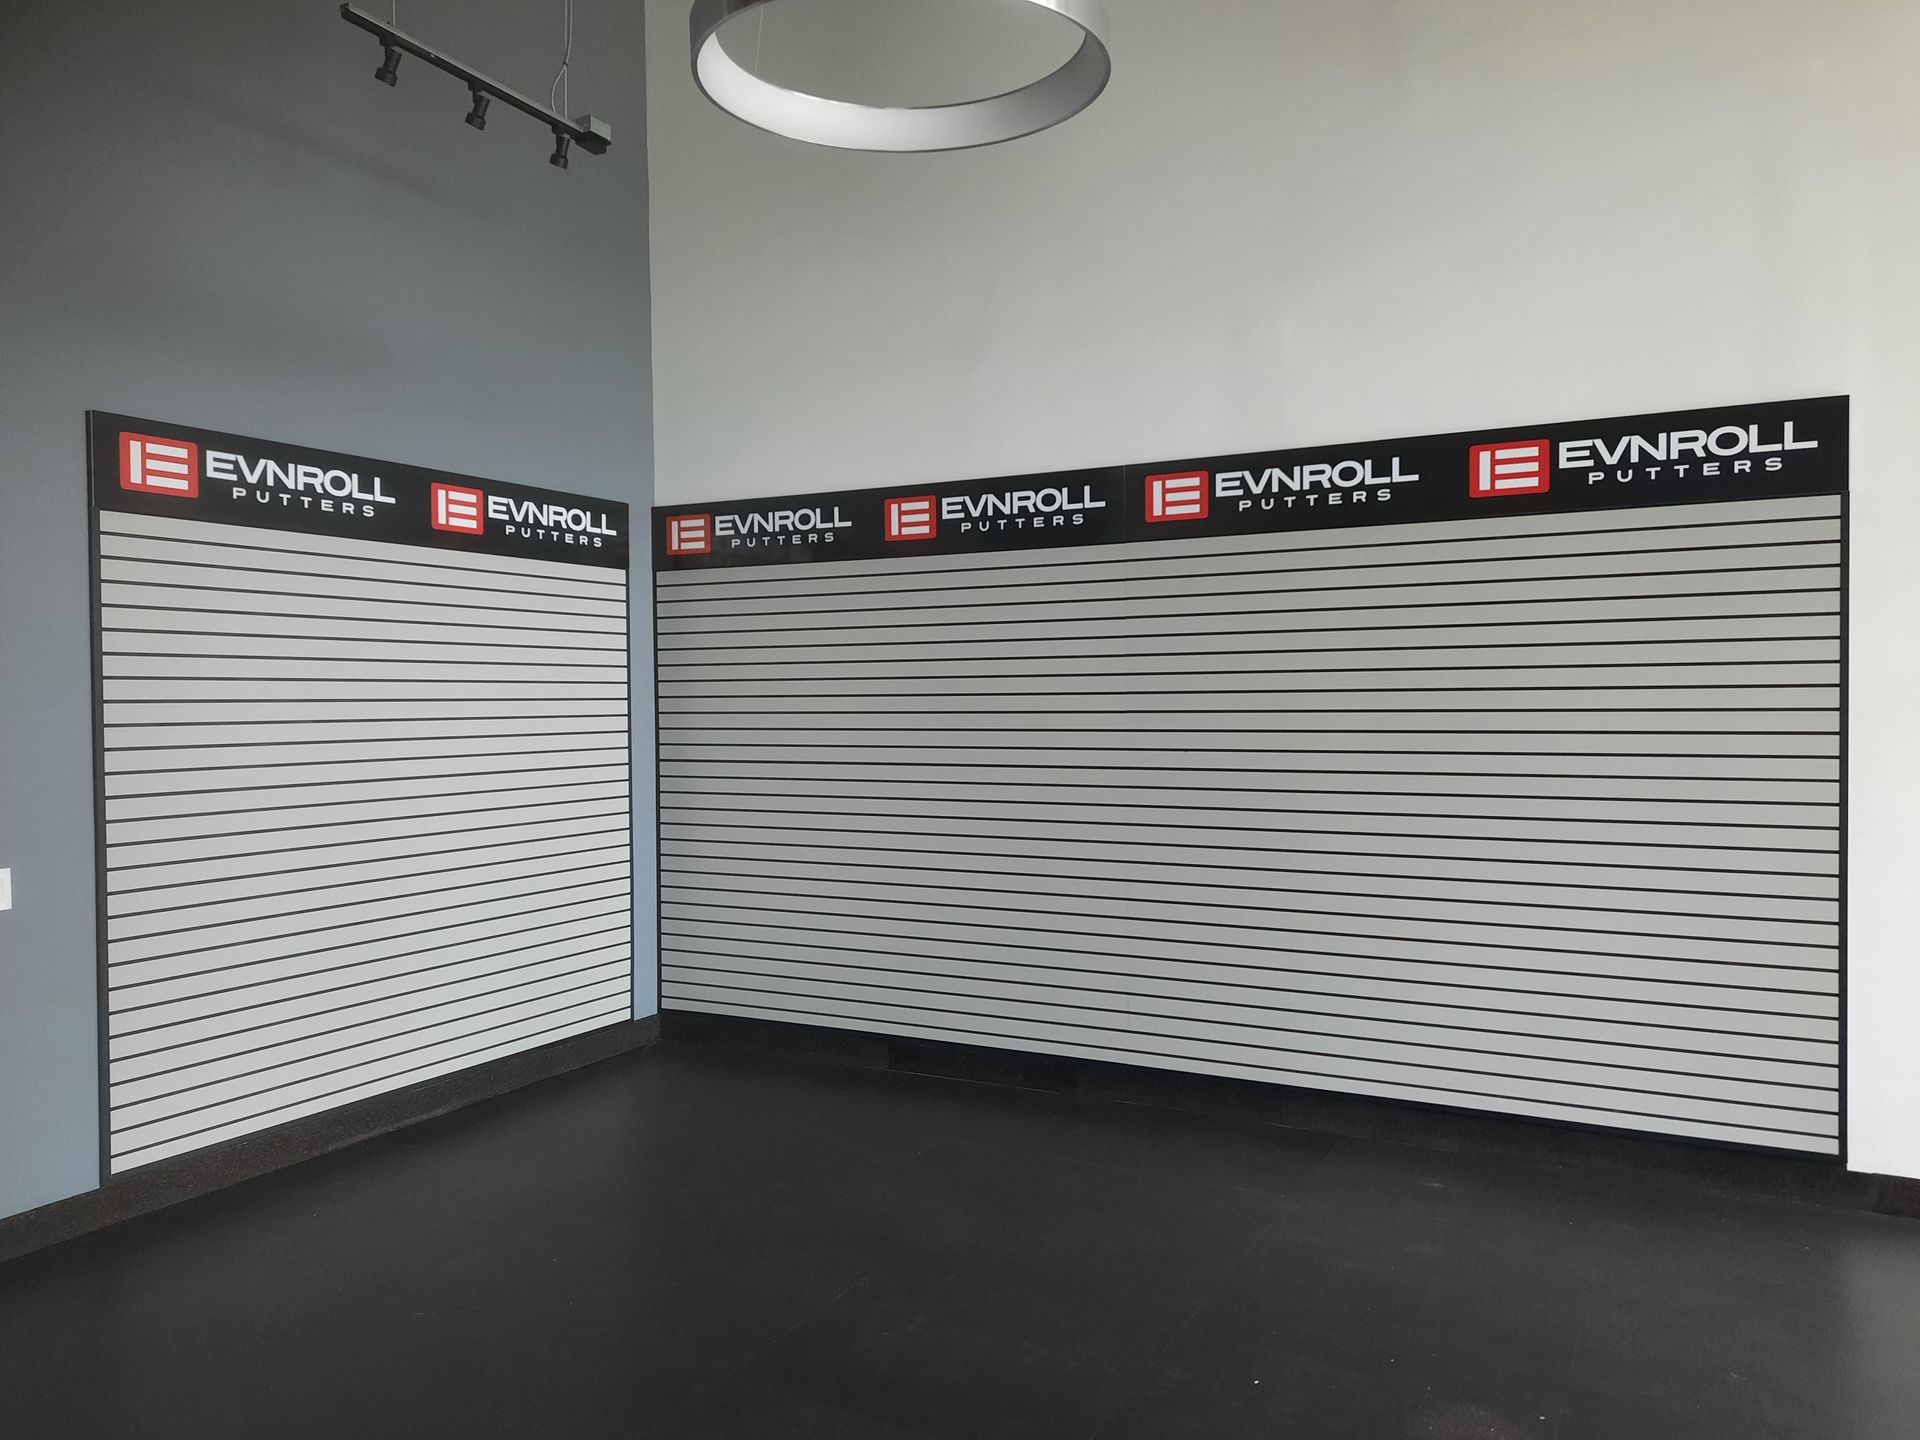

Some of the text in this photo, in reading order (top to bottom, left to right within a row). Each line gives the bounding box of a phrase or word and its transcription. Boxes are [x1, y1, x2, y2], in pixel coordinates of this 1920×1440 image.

[1559, 421, 1818, 469] EVNROLL
[206, 449, 395, 504] EVNROLL
[1216, 457, 1419, 497] EVNROLL
[1589, 458, 1783, 485] PUTTERS
[233, 487, 375, 517] PUTTERS
[942, 485, 1106, 519] EVNROLL
[1239, 489, 1391, 512] PUTTERS
[488, 495, 617, 536] EVNROLL
[715, 507, 852, 536] EVNROLL
[961, 513, 1084, 533] PUTTERS
[506, 525, 603, 547] PUTTERS
[731, 532, 834, 549] PUTTERS
